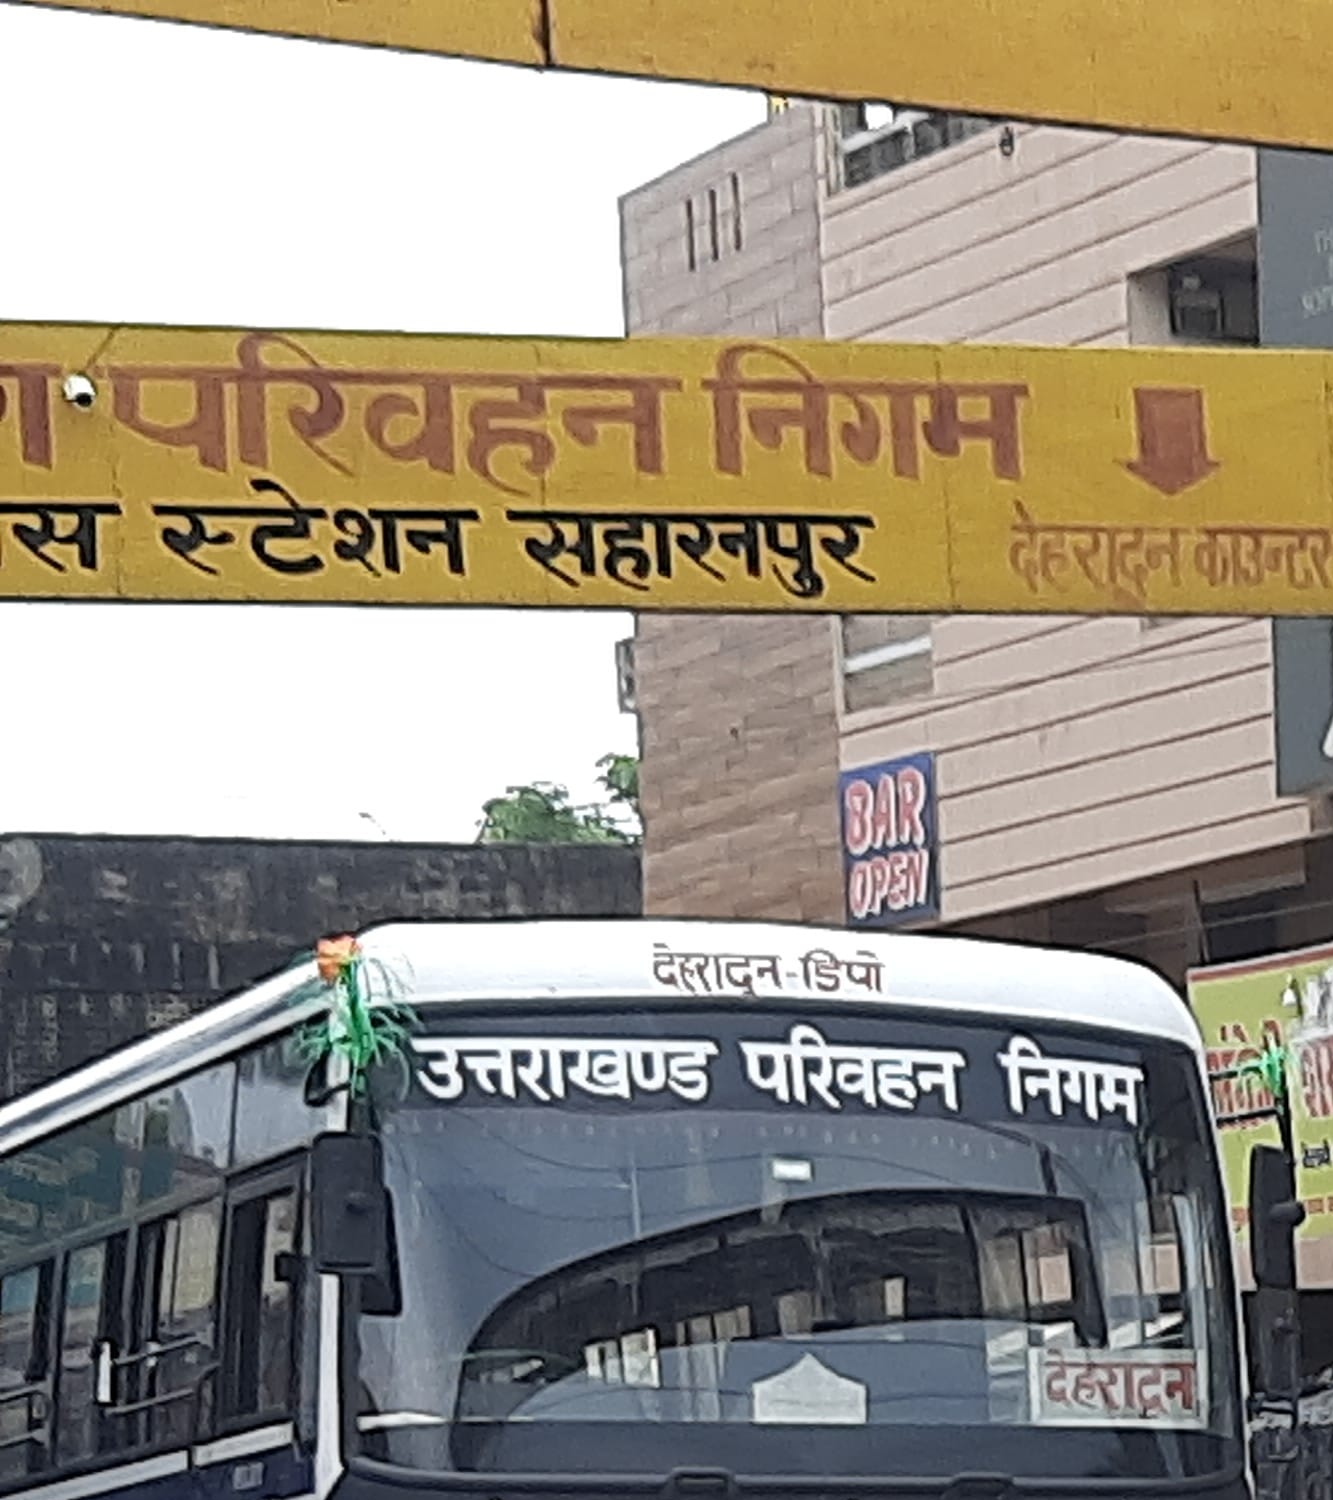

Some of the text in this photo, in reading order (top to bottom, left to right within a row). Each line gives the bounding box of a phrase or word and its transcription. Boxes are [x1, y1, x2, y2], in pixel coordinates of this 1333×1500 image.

[107, 333, 682, 498] परिवहन
[703, 342, 1030, 482] निगम
[153, 479, 480, 577] स्टेशन
[507, 510, 877, 600] सहारनपुर
[845, 766, 926, 857] BAR
[850, 847, 929, 920] OPEN
[411, 1037, 718, 1103] उत्तराखण्ड
[740, 1023, 967, 1112] परिवहन
[998, 1033, 1144, 1127] निगम
[1043, 1348, 1197, 1419] देहरादून
